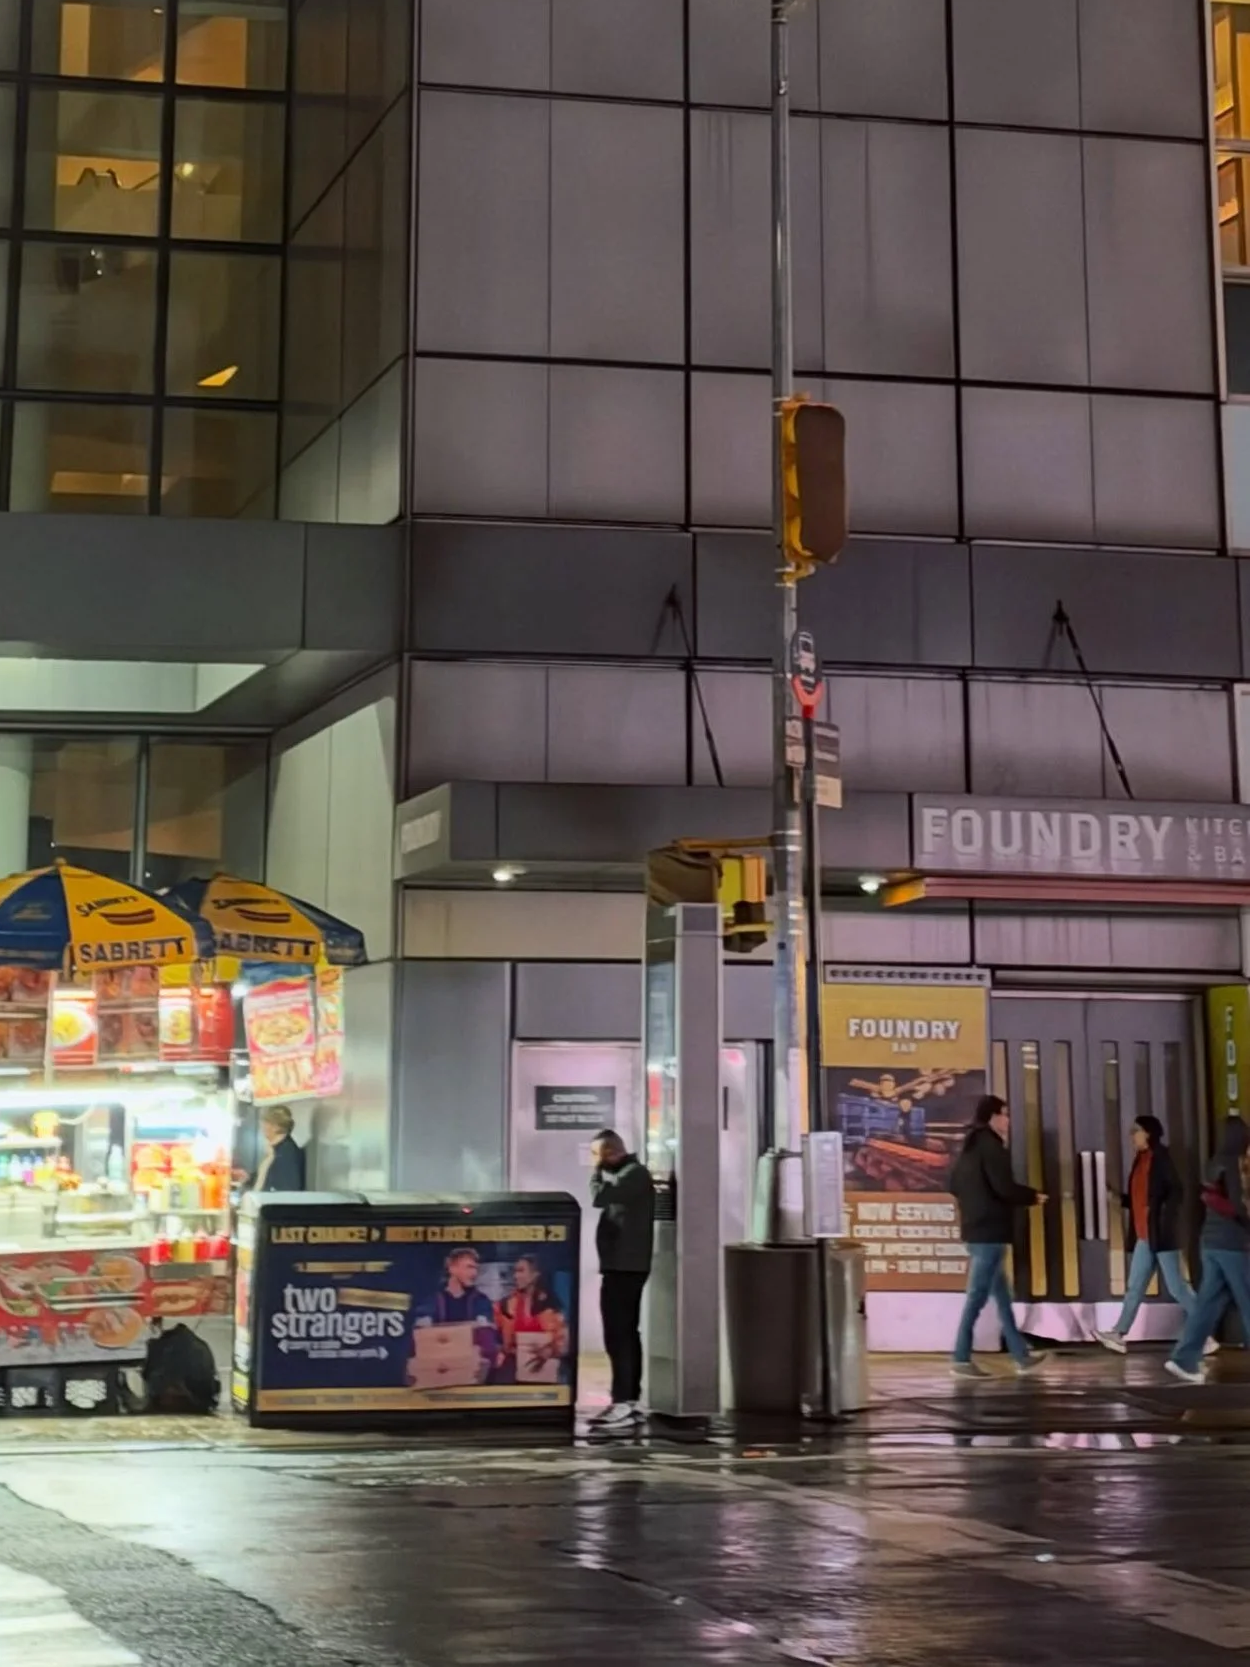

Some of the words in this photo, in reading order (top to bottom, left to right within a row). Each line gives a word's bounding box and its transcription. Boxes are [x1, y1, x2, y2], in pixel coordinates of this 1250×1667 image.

[921, 807, 1174, 862] FOUNDRY
[1186, 818, 1250, 836] KITC
[79, 937, 187, 963] SABRETT
[217, 932, 316, 957] ABRETT
[848, 1018, 960, 1040] FOUNDRY
[1225, 1005, 1240, 1117] FOU
[283, 1283, 337, 1313] two
[270, 1310, 406, 1345] strangers
